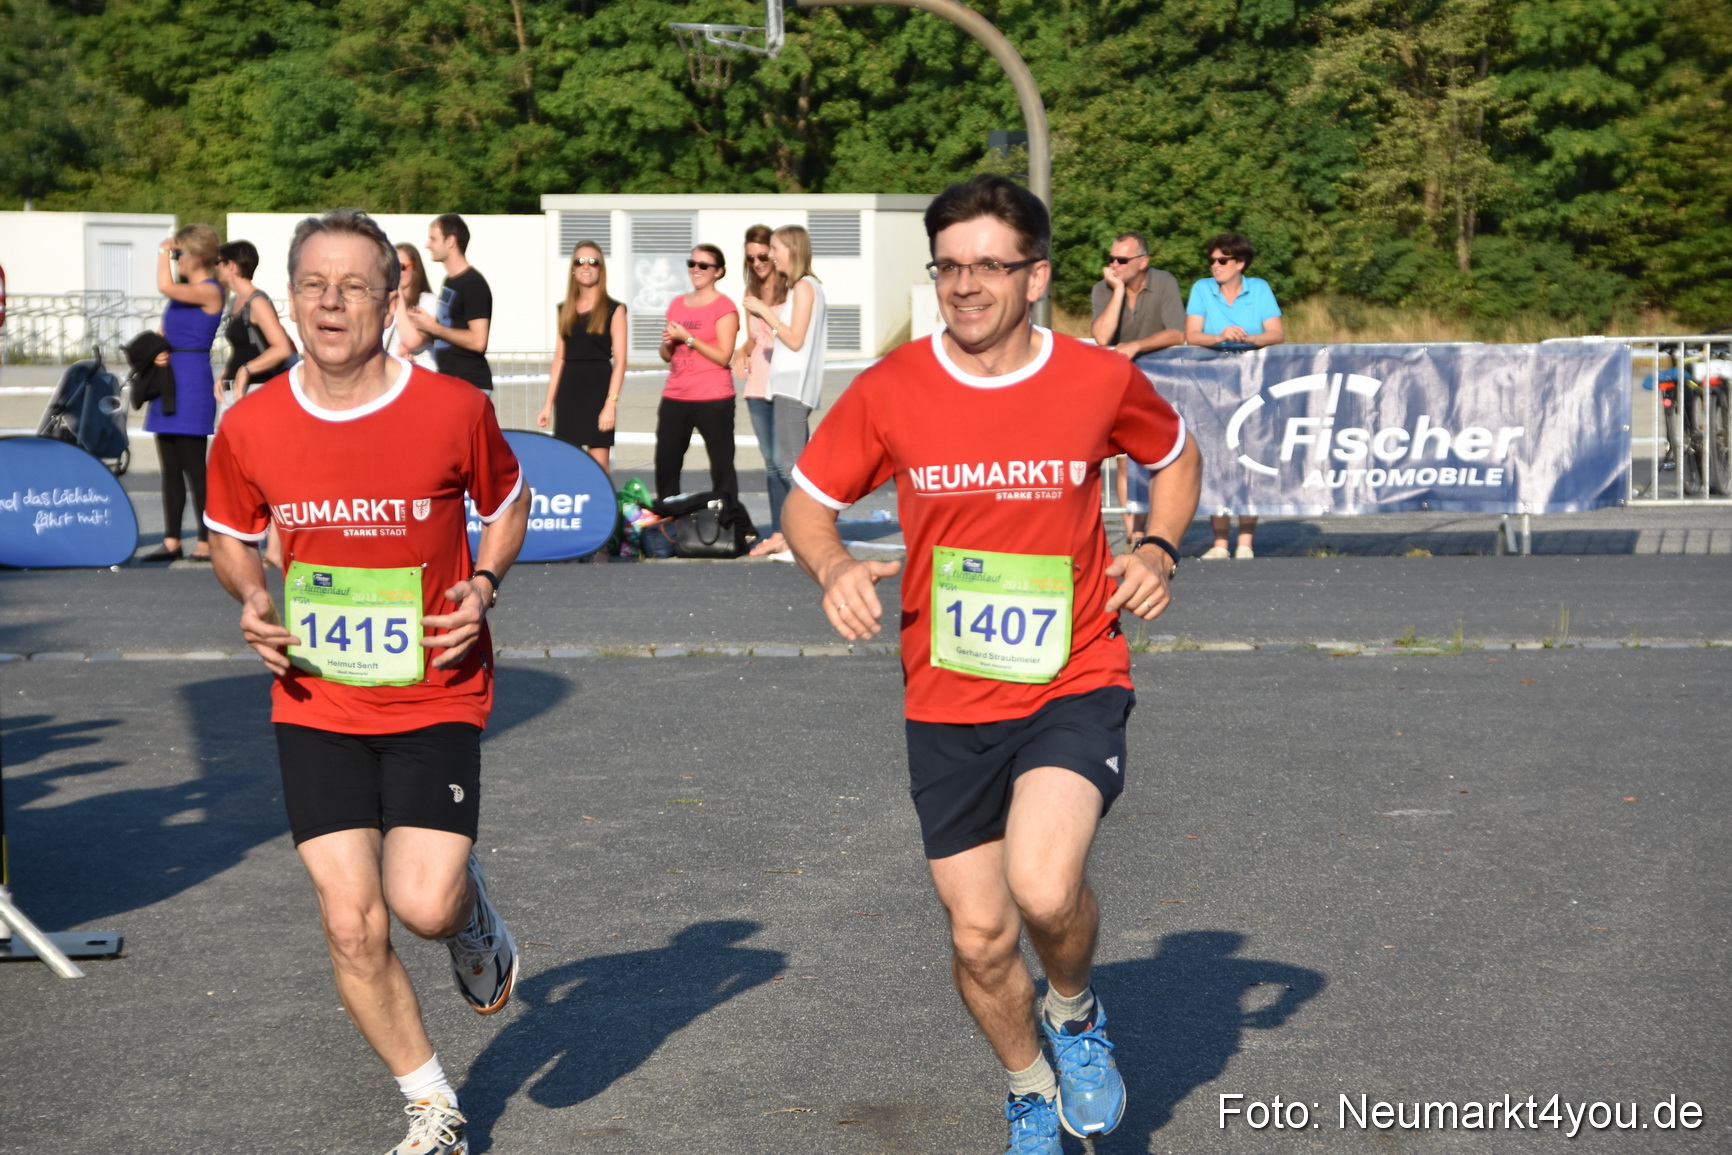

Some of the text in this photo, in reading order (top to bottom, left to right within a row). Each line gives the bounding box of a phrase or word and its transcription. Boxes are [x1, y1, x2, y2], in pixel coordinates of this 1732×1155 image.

[1280, 415, 1525, 462] Fischer
[909, 460, 1064, 490] NEUMARKT
[1302, 467, 1505, 488] AUTOMOBILE
[23, 488, 50, 507] das
[995, 492, 1032, 500] STARKE
[33, 509, 109, 535] fährt mit!
[270, 499, 405, 526] NEUMARKT
[343, 529, 377, 537] STARKE
[952, 569, 1002, 583] firmenlauf
[305, 583, 351, 596] firmenlauf
[300, 612, 409, 654] 1415
[946, 600, 1058, 647] 1407
[327, 659, 379, 670] Helmut Senft
[956, 646, 1041, 664] Gerhard Straubmeier
